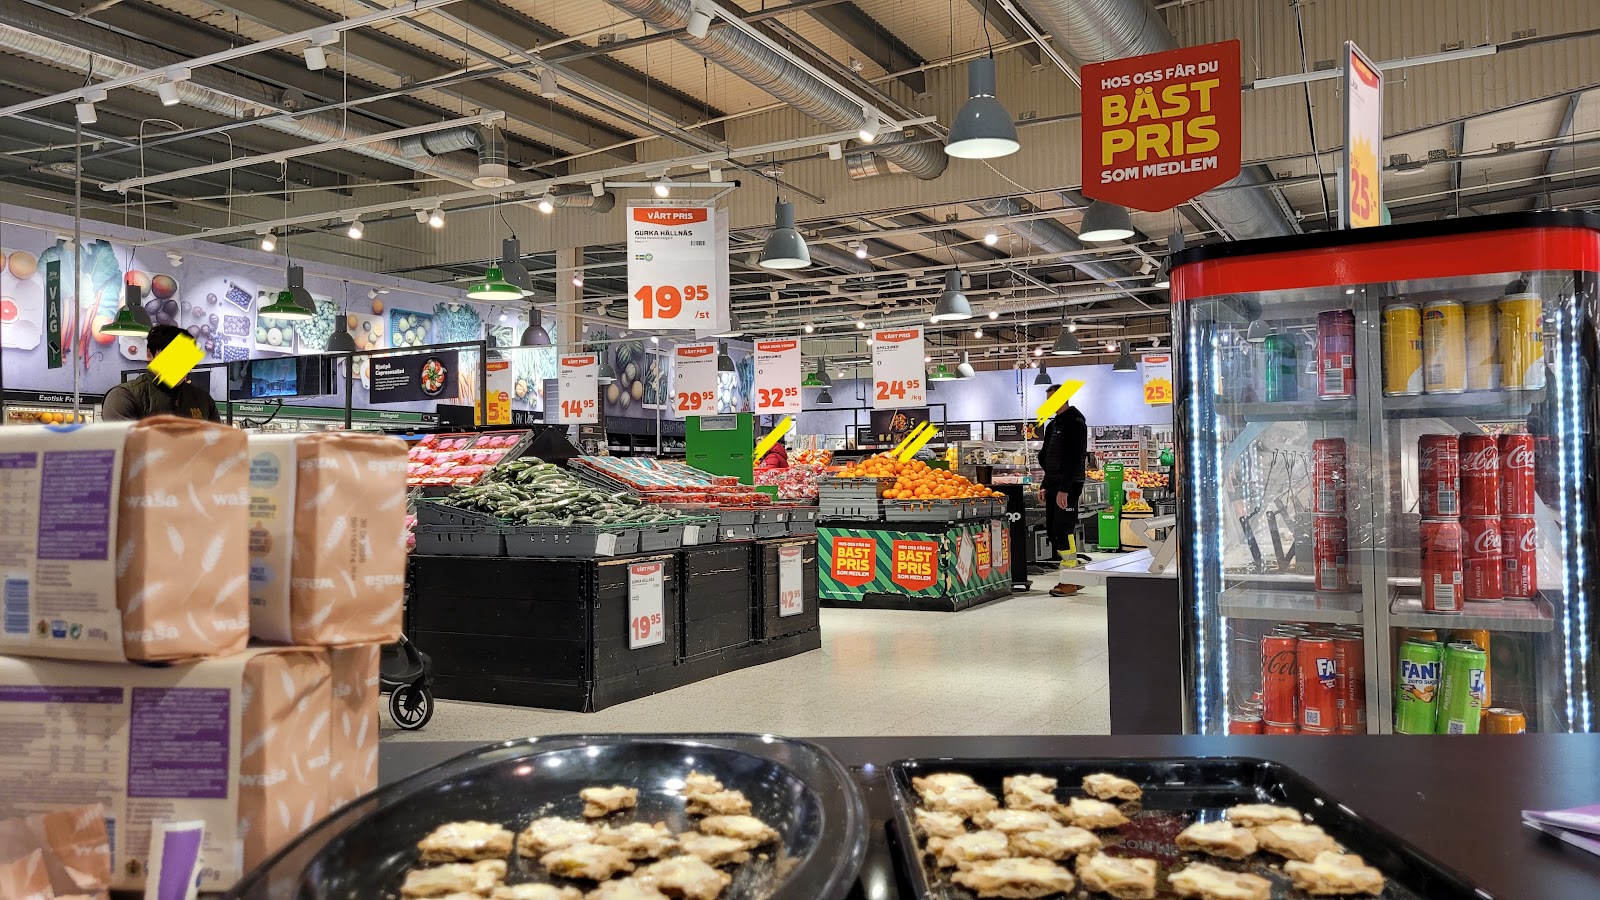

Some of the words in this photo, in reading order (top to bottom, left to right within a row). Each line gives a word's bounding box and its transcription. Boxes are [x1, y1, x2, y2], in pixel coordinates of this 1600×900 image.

[1101, 75, 1131, 90] HOS
[1133, 69, 1163, 85] OSS
[1165, 63, 1195, 80] FÅR
[1198, 60, 1219, 75] DU
[1101, 78, 1220, 127] BÄST
[1101, 115, 1220, 166] PRIS
[1100, 166, 1139, 184] SOM
[1142, 155, 1218, 178] MEDLEM
[647, 211, 672, 220] VÅRT
[672, 212, 694, 220] PRIS
[660, 229, 693, 237] HÄLLNÄS
[634, 285, 682, 319] 19
[684, 285, 709, 301] 95
[695, 310, 710, 319] /st
[758, 387, 785, 408] 32
[785, 387, 798, 397] 95
[876, 380, 906, 400] 24
[906, 380, 920, 389] 95
[561, 399, 583, 418] 14
[583, 399, 595, 408] 95
[677, 391, 702, 411] 29
[702, 391, 714, 400] 95
[837, 547, 871, 559] BÄST
[897, 550, 932, 562] BÄST
[836, 558, 870, 571] PRIS
[897, 561, 932, 575] PRIS
[781, 591, 795, 609] 42
[794, 590, 800, 598] 95
[632, 615, 651, 641] 19
[650, 613, 661, 625] 95
[1316, 658, 1336, 676] FA
